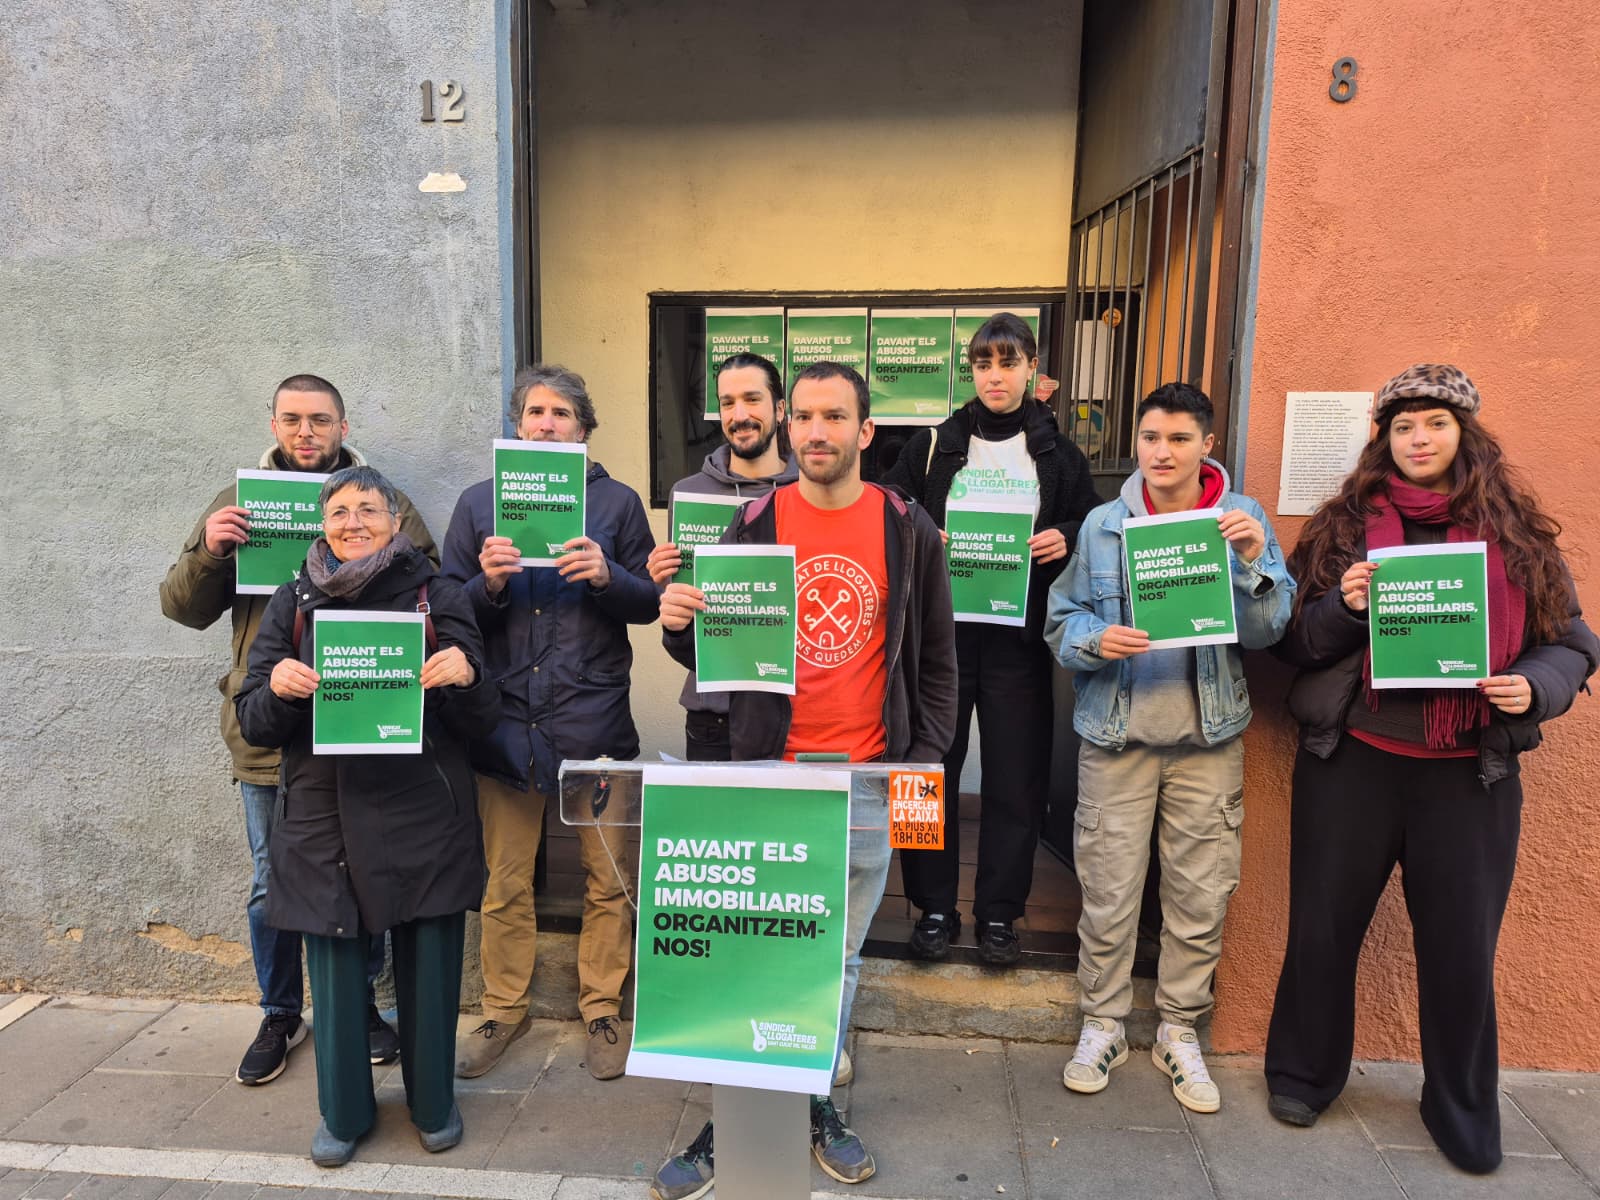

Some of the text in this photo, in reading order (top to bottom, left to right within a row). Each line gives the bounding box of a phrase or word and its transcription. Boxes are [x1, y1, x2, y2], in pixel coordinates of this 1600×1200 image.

[1329, 56, 1358, 104] 8
[419, 79, 466, 123] 12
[712, 336, 769, 344] DAVANT ELS
[793, 336, 852, 344] DAVANT ELS
[876, 337, 936, 346] DAVANT ELS
[712, 345, 750, 353] ABUSOS
[793, 346, 832, 354] ABUSOS
[876, 347, 916, 355] ABUSOS
[793, 354, 860, 363] IMMOBILIARIS,
[876, 356, 945, 365] IMMOBILIARIS,
[876, 366, 943, 374] ORGANITZEM-
[876, 375, 898, 383] NOS!
[501, 472, 568, 483] DAVANT ELS
[501, 482, 546, 492] ABUSOS
[501, 492, 578, 504] IMMOBILIARIS,
[244, 500, 316, 512] DAVANT ELS
[502, 502, 576, 513] ORGANITZEM-
[502, 512, 528, 521] NOS!
[678, 523, 721, 534] DAVANT
[678, 533, 721, 544] ABUSOS
[952, 532, 1016, 543] DAVANT ELS
[245, 540, 272, 548] NOS!
[950, 542, 994, 551] ABUSOS
[1133, 542, 1208, 560] DAVANT ELS
[950, 552, 1024, 563] IMMOBILIARIS,
[1135, 556, 1184, 570] ABUSOS
[950, 560, 1021, 572] ORGANITZEM-
[950, 570, 974, 578] NOS!
[1136, 563, 1222, 581] IMMOBILIARIS,
[702, 582, 777, 592] DAVANT ELS
[1137, 574, 1220, 592] ORGANITZEM-
[1377, 580, 1464, 592] DAVANT ELS
[813, 560, 830, 572] DE
[834, 561, 875, 626] LLOGATERES
[1138, 591, 1167, 602] NOS!
[1378, 592, 1435, 603] ABUSOS
[1378, 602, 1478, 615] IMMOBILIARIS,
[703, 616, 788, 627] ORGANITZEM-
[1378, 614, 1476, 626] ORGANITZEM-
[704, 628, 732, 637] NOS!
[1379, 626, 1412, 637] NOS!
[323, 646, 404, 656] DAVANT ELS
[796, 638, 863, 663] NS QUEDEM
[322, 658, 378, 668] ABUSOS
[322, 669, 416, 680] IMMOBILIARIS,
[322, 680, 414, 690] ORGANITZEM-
[323, 692, 354, 702] NOS!
[893, 774, 926, 800] 17D
[892, 800, 939, 810] ENCERCLEM
[892, 810, 939, 823] LA CAIXA
[892, 821, 939, 833] PL PIUS XII
[893, 831, 939, 845] 18H BCN
[656, 837, 808, 864] DAVANT ELS
[654, 863, 756, 886] ABUSOS
[653, 887, 832, 918] IMMOBILIARIS,
[652, 912, 826, 940] ORGANITZEM-
[652, 936, 712, 958] NOS!
[758, 1022, 797, 1034] SINDICAT
[766, 1031, 817, 1045] LLOGATERES
